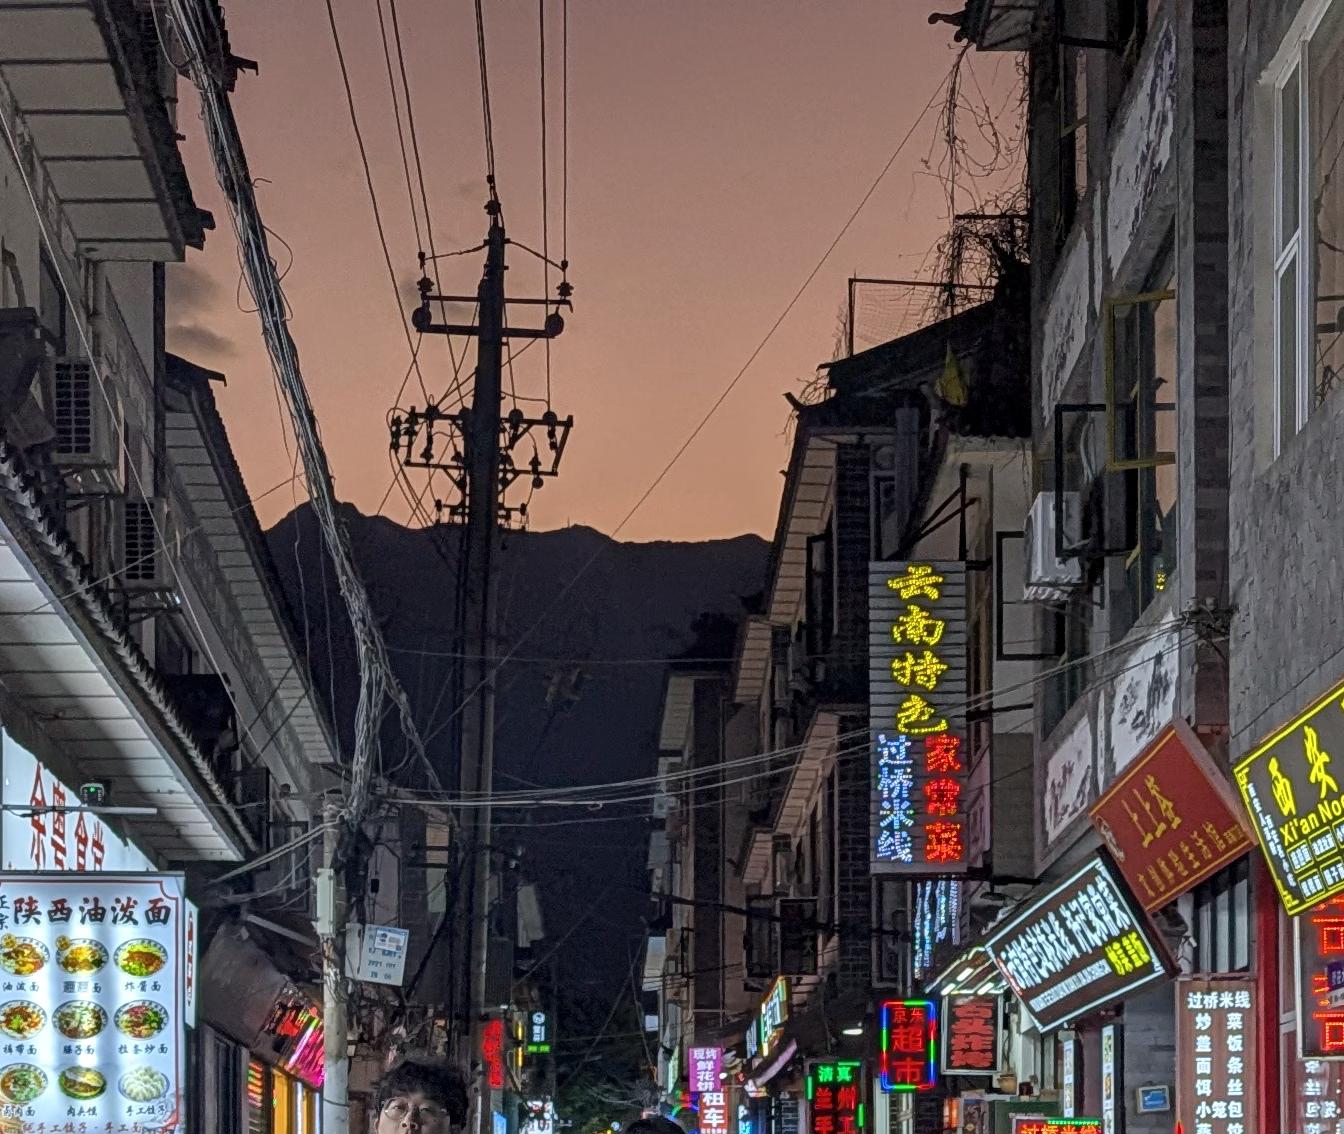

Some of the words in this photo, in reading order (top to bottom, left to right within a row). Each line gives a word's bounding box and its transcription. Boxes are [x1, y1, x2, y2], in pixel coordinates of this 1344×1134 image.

[889, 565, 949, 734] 云南特色
[876, 735, 913, 863] 过桥米线
[925, 735, 962, 863] 家常菜
[1280, 811, 1319, 846] Xi'an
[14, 897, 172, 926] 陕西油泼面
[1188, 991, 1251, 1009] 过桥米线
[892, 1007, 923, 1023] 京东
[1196, 1013, 1244, 1030] 炒菜
[1196, 1035, 1244, 1052] 盖饭
[891, 1027, 924, 1084] 超市
[818, 1065, 852, 1082] 清真
[1196, 1057, 1244, 1074] 面条
[1196, 1079, 1244, 1096] 饵丝
[702, 1091, 725, 1127] 租车
[1196, 1101, 1244, 1119] 小笼包
